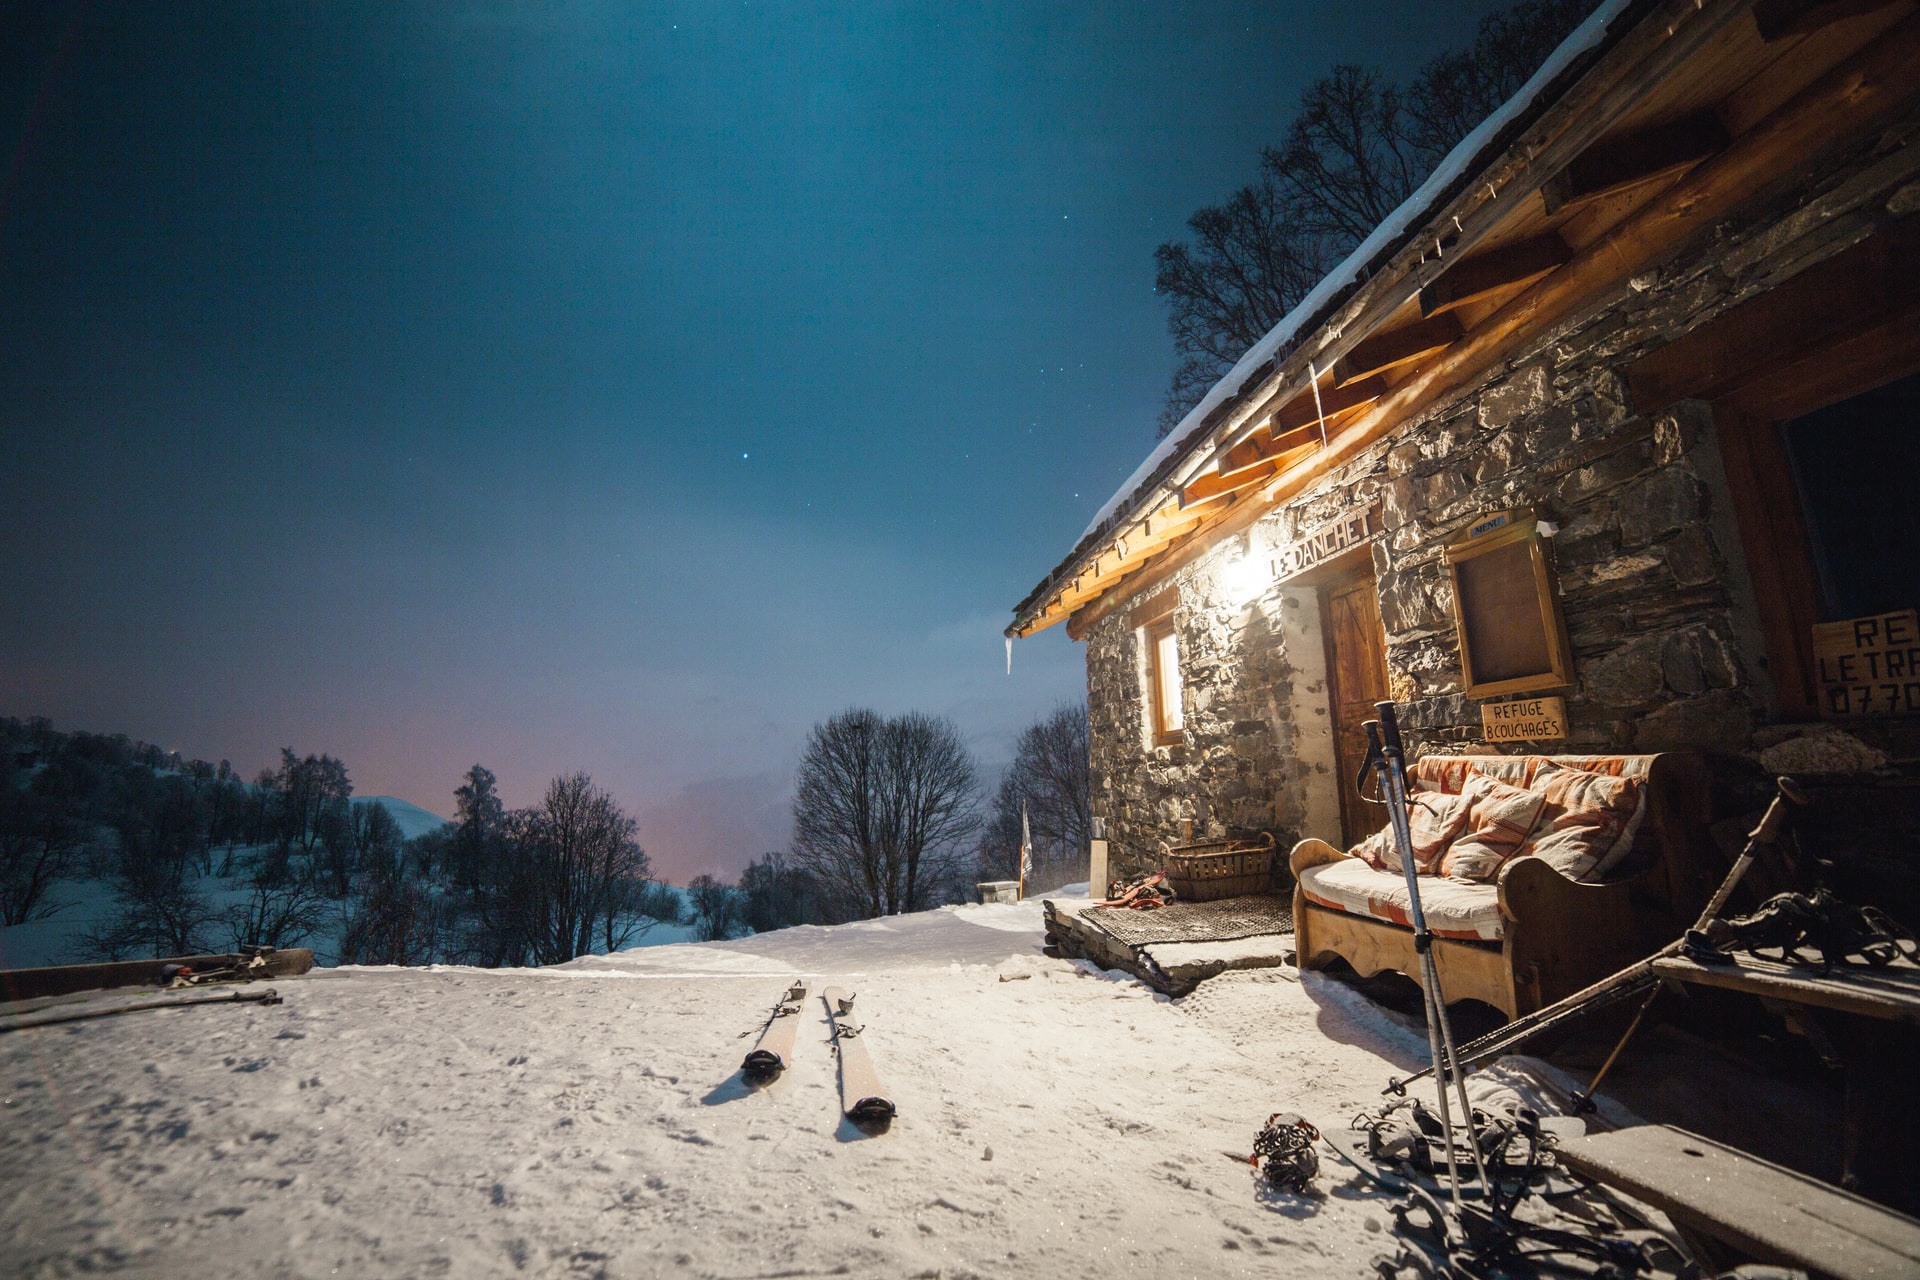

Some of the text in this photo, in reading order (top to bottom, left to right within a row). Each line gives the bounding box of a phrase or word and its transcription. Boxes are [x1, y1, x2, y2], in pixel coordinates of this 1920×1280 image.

[1475, 517, 1502, 534] MENU
[1267, 508, 1370, 580] LE DANCHET
[1854, 614, 1920, 648] RE
[1494, 701, 1545, 719] REFUGE
